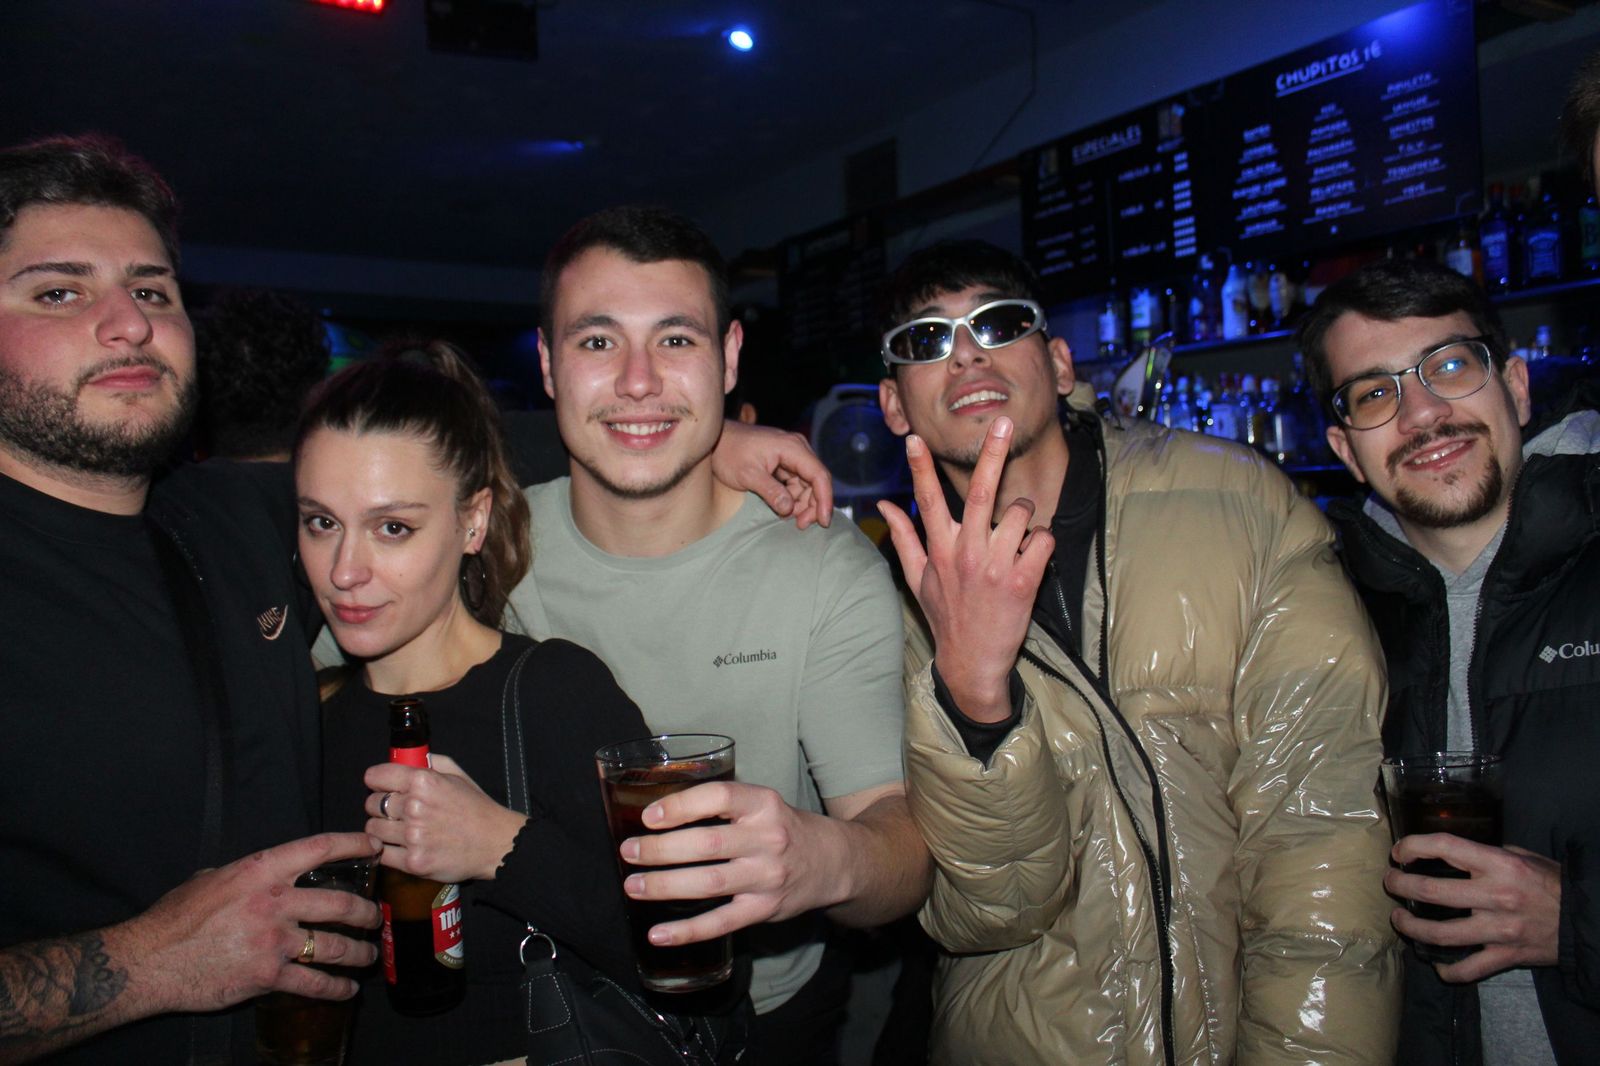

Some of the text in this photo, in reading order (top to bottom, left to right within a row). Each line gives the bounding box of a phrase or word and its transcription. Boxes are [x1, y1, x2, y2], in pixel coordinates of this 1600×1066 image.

[1275, 47, 1360, 91] CHUPITOS
[1072, 122, 1143, 161] ESPECIALES
[257, 606, 281, 632] NIKE
[723, 649, 777, 665] Columbia
[1558, 640, 1600, 659] Colu
